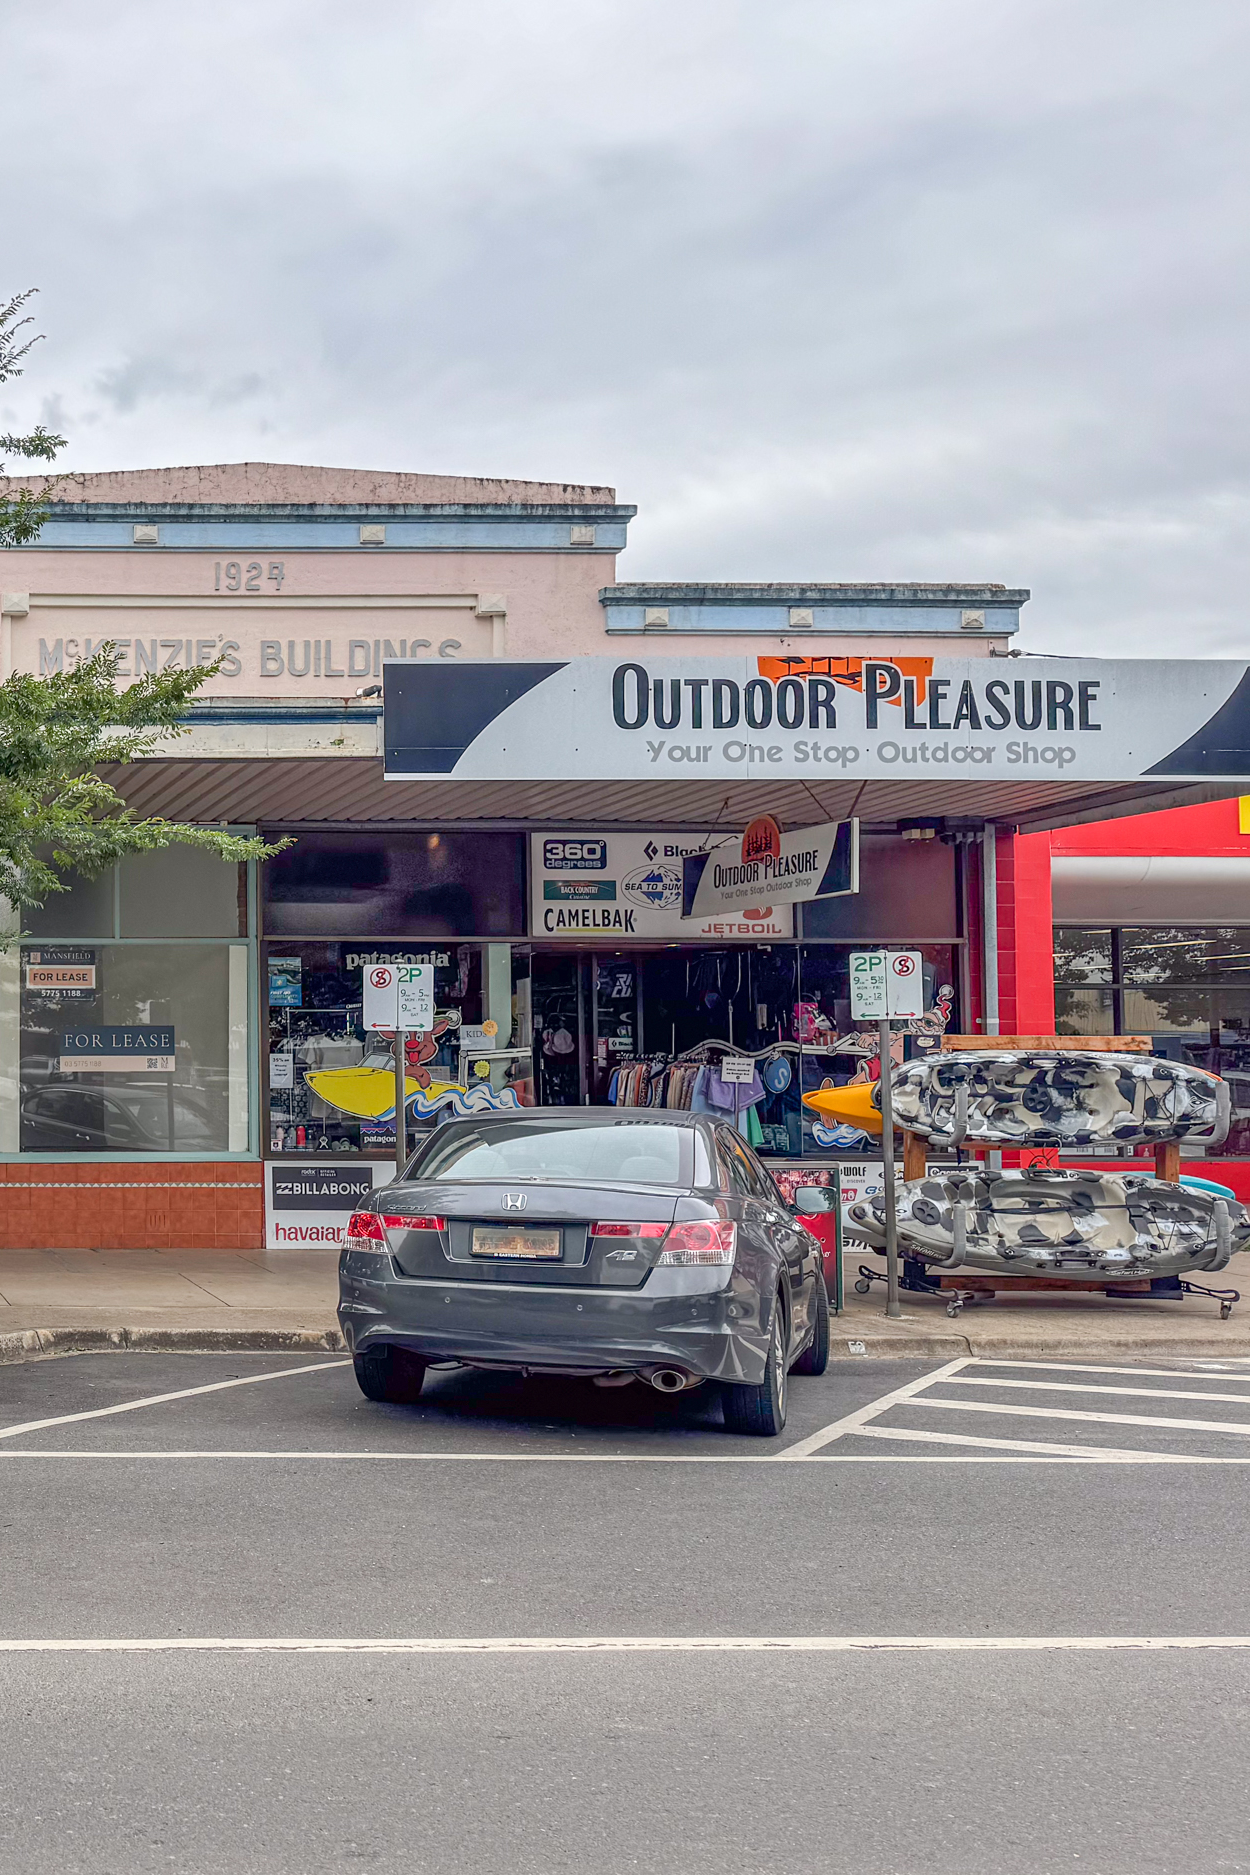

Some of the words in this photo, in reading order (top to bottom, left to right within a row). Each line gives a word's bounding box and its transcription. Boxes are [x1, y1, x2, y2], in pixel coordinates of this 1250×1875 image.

[646, 740, 712, 763] Your
[722, 740, 783, 763] One
[793, 740, 860, 768] Stop
[876, 741, 996, 764] Outdoor
[1006, 741, 1077, 769] Shop
[546, 859, 601, 869] degrees
[560, 886, 575, 894] BACK
[575, 886, 599, 894] COUNTRY
[624, 883, 643, 891] SEA
[646, 883, 658, 891] TO
[661, 883, 682, 891] SUM
[720, 891, 734, 900] Your
[735, 888, 748, 898] One
[750, 886, 764, 895] Stop
[766, 881, 793, 893] Outdoor
[795, 878, 812, 888] Shop
[701, 923, 782, 934] JETBOIL
[43, 951, 91, 960] MANSFIELD
[854, 956, 882, 972] 2P
[33, 973, 54, 982] FOR
[56, 973, 88, 982] LEASE
[397, 967, 423, 983] 2P
[41, 989, 60, 997] 5775
[62, 989, 81, 997] 1188
[64, 1034, 103, 1048] FOR
[112, 1034, 170, 1048] LEASE
[64, 1060, 73, 1068] 03
[73, 1060, 88, 1068] 5775
[89, 1060, 102, 1068] 1188
[363, 1135, 397, 1144] patagon
[841, 1166, 867, 1177] WOLF
[293, 1182, 370, 1195] BILLABONG
[275, 1222, 346, 1244] havaia
